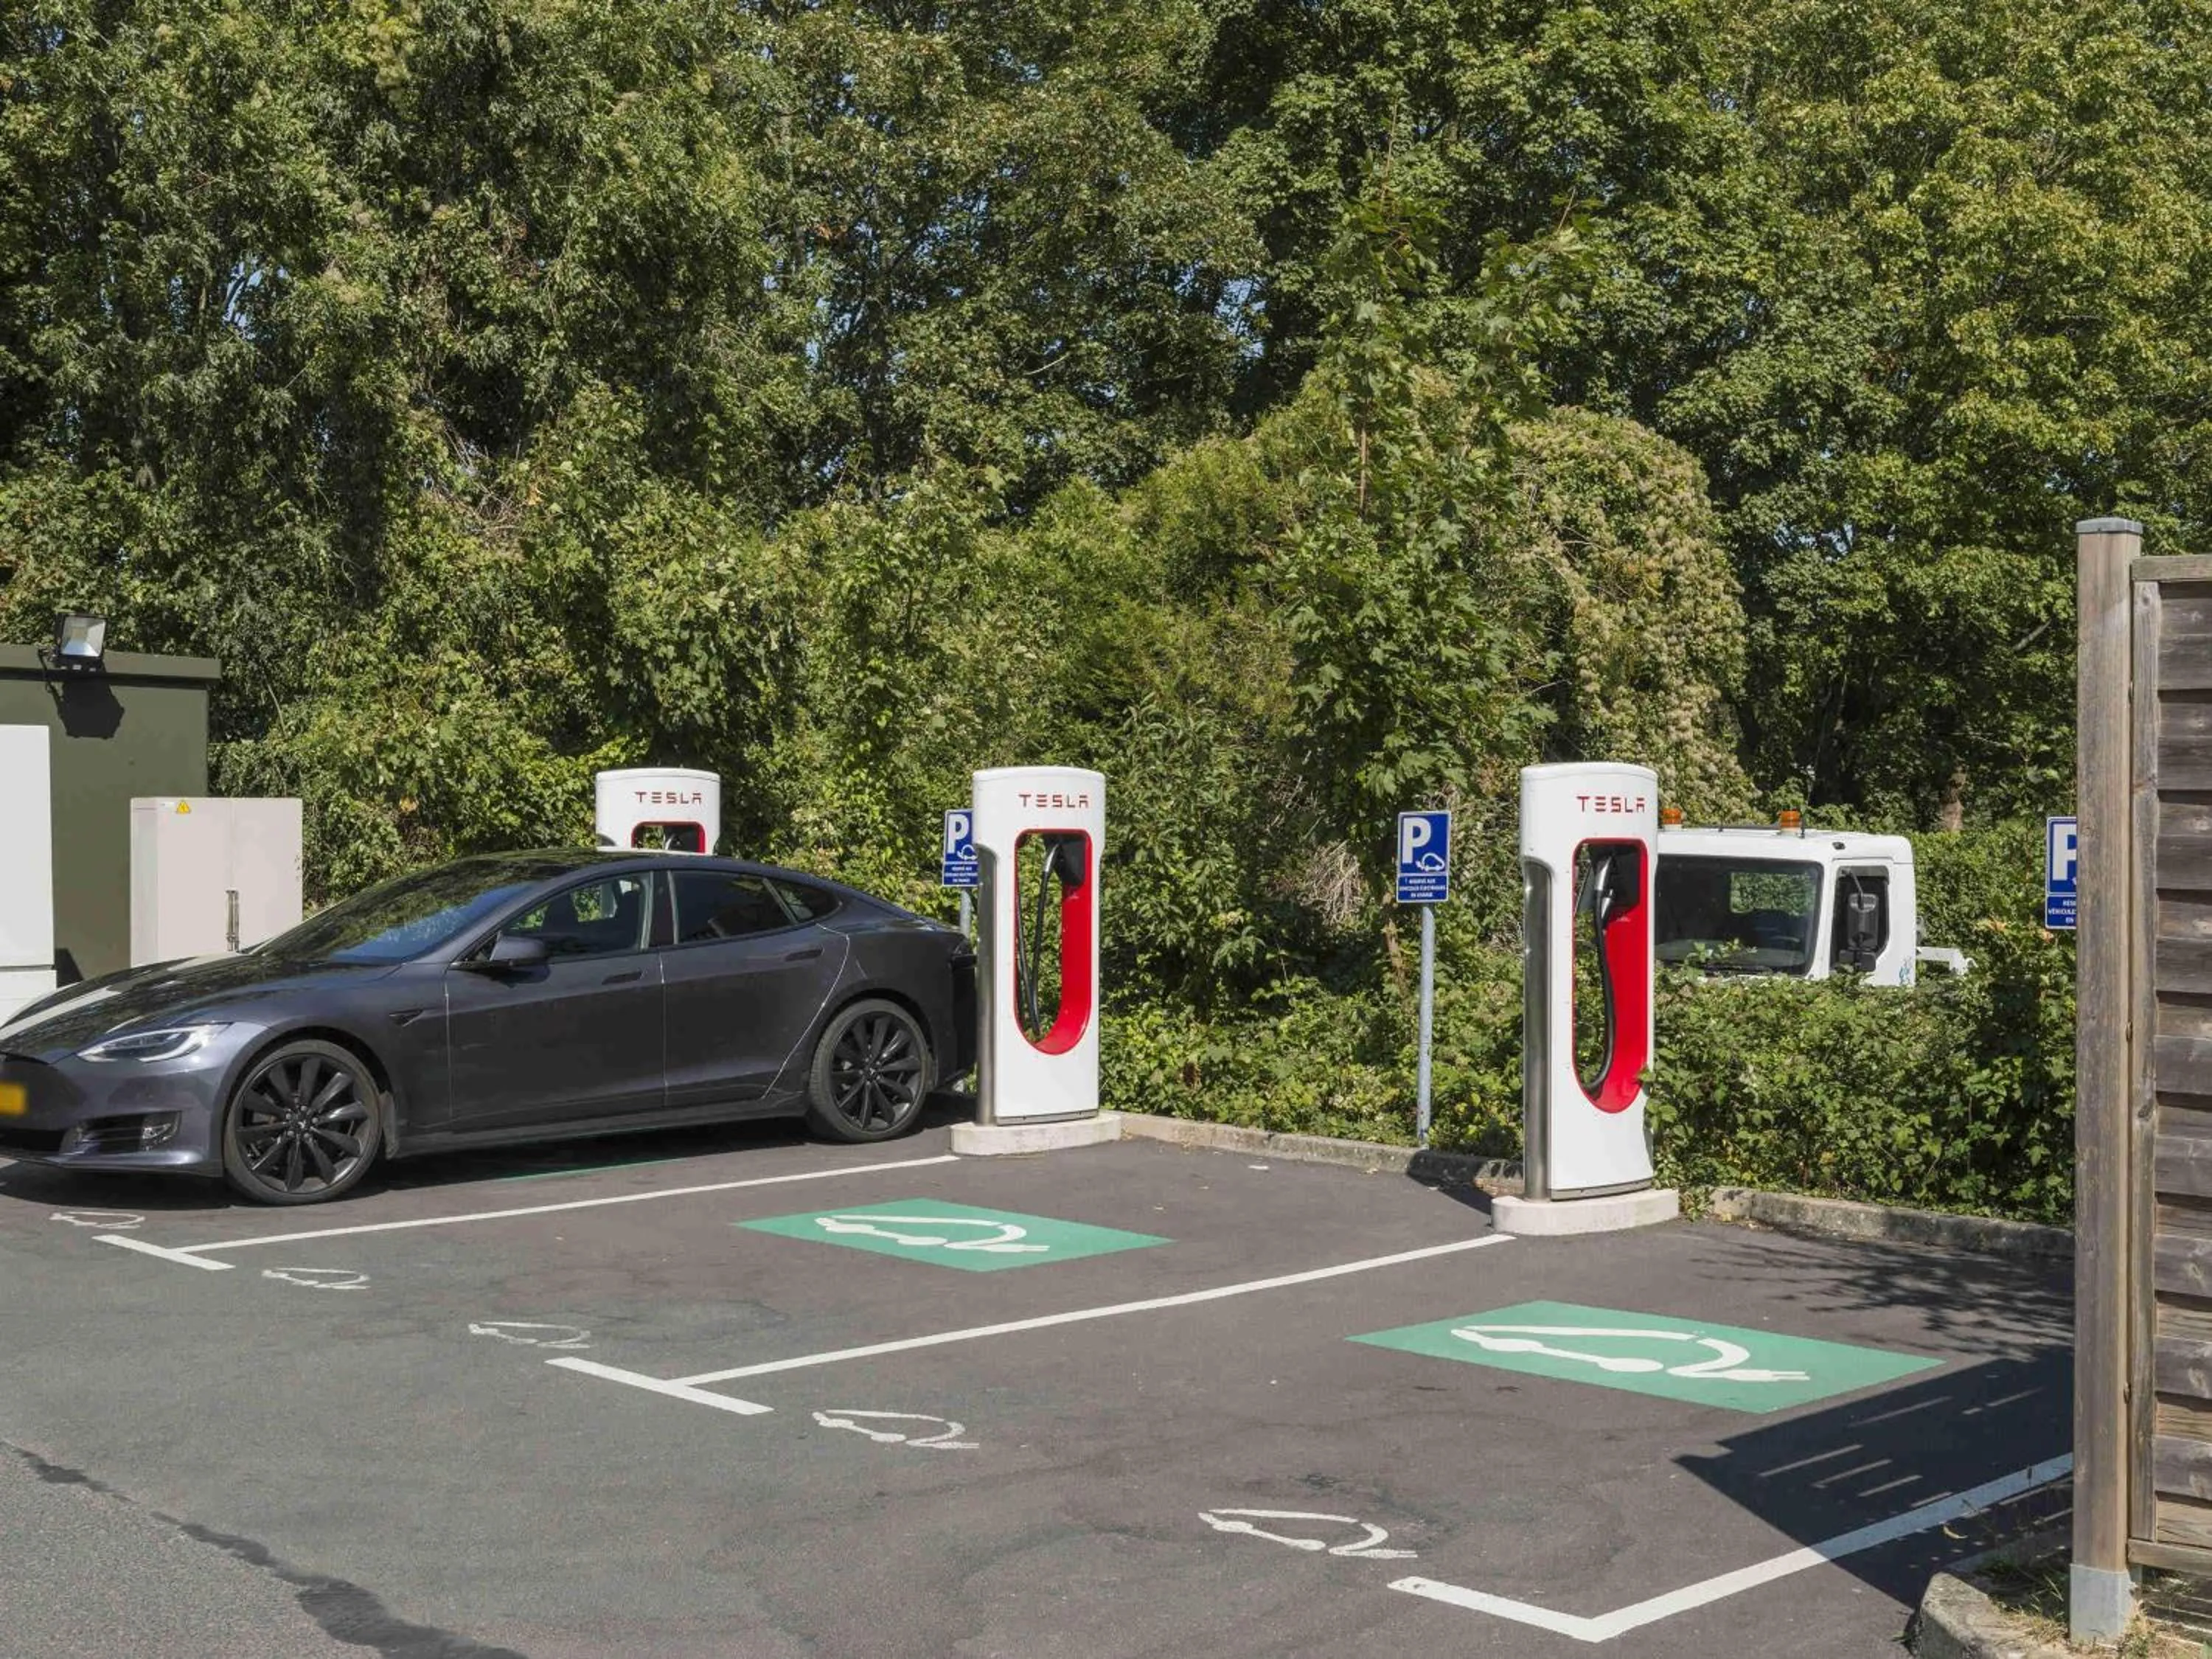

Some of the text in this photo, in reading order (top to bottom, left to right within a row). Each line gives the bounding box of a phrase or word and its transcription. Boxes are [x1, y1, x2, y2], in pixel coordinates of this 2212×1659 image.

[635, 791, 702, 804] TESLA
[1018, 794, 1088, 808] TESLA
[1576, 796, 1645, 813] TESLA
[947, 813, 970, 854] P
[1402, 817, 1431, 863] P
